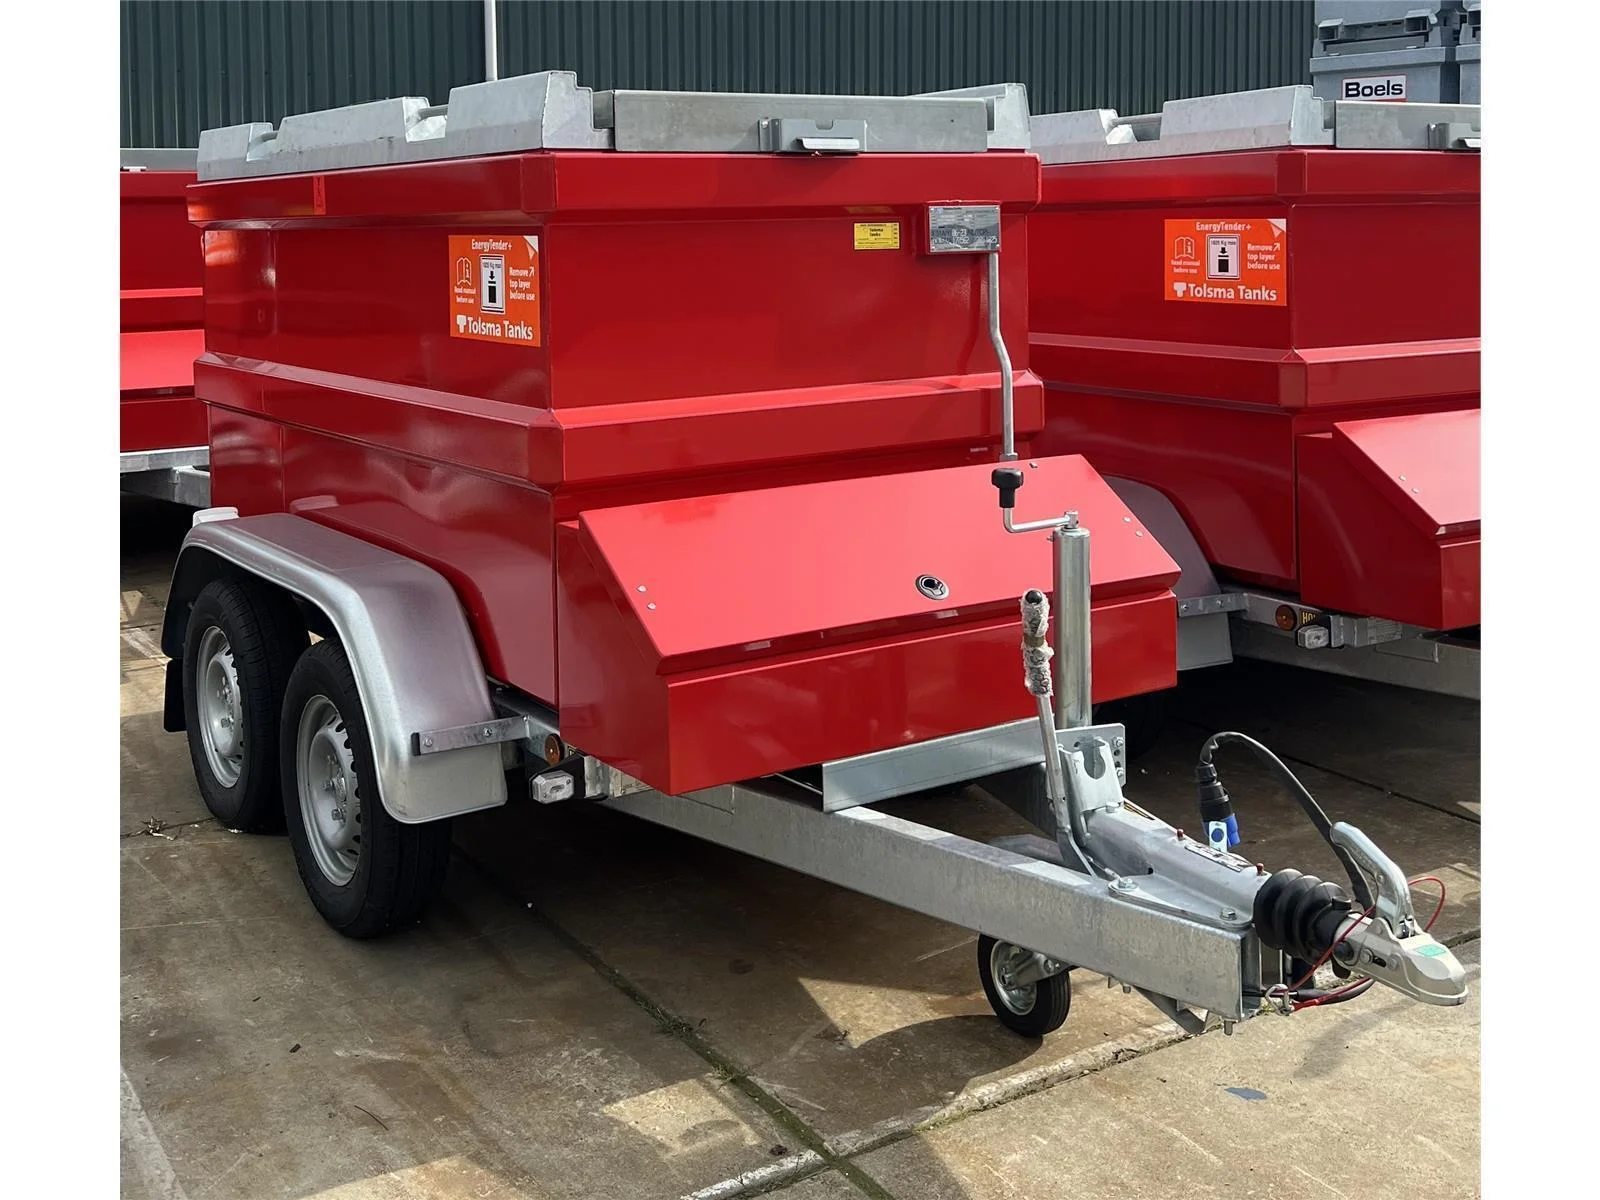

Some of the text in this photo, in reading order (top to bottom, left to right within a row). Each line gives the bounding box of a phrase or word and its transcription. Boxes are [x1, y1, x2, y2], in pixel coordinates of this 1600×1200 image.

[1345, 80, 1403, 97] Boels
[1195, 222, 1252, 232] EnergyTender+
[471, 239, 512, 252] EnergyTender+
[1247, 243, 1273, 251] Remove
[1247, 253, 1275, 262] top layer
[1247, 262, 1267, 270] before
[509, 267, 529, 277] Remove
[509, 280, 531, 291] top layer
[509, 291, 535, 301] before use
[1188, 283, 1277, 301] Tolsma Tanks
[467, 317, 533, 340] Tolsma Tanks
[1302, 612, 1316, 624] HO
